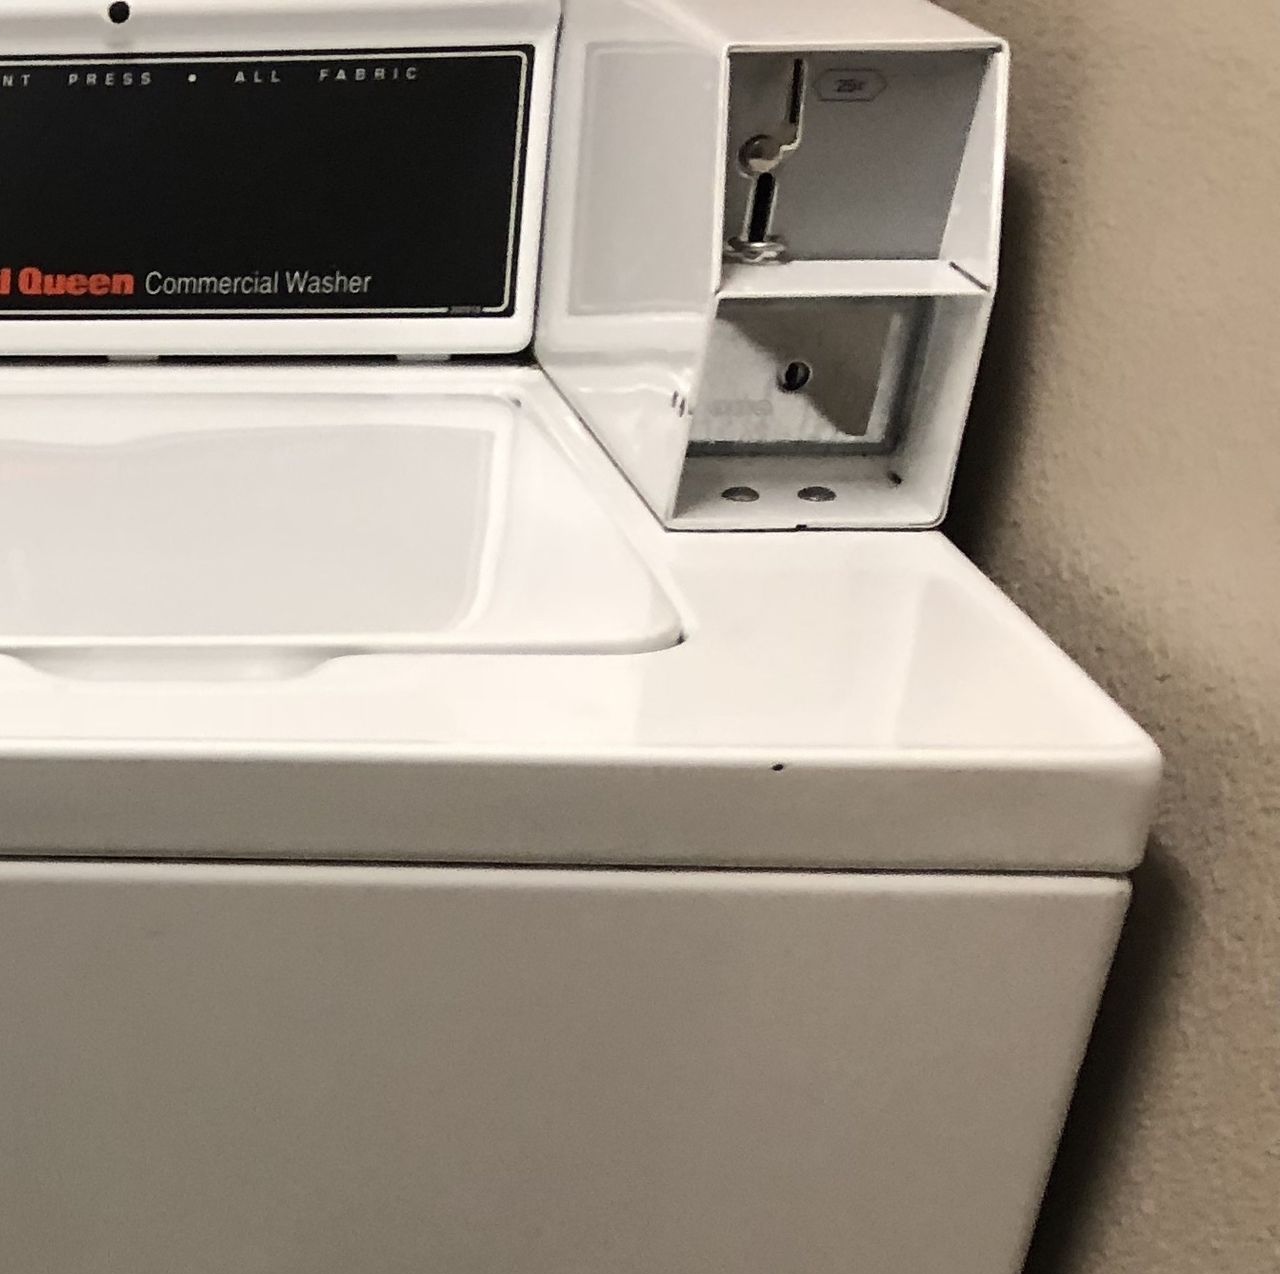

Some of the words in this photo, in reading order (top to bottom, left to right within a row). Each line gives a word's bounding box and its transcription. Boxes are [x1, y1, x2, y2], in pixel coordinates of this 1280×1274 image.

[67, 71, 152, 86] PRESS
[233, 69, 281, 83] ALL
[318, 66, 418, 82] FABRIC
[17, 266, 135, 297] Queen
[144, 270, 280, 296] Commercial
[284, 270, 373, 295] Washer
